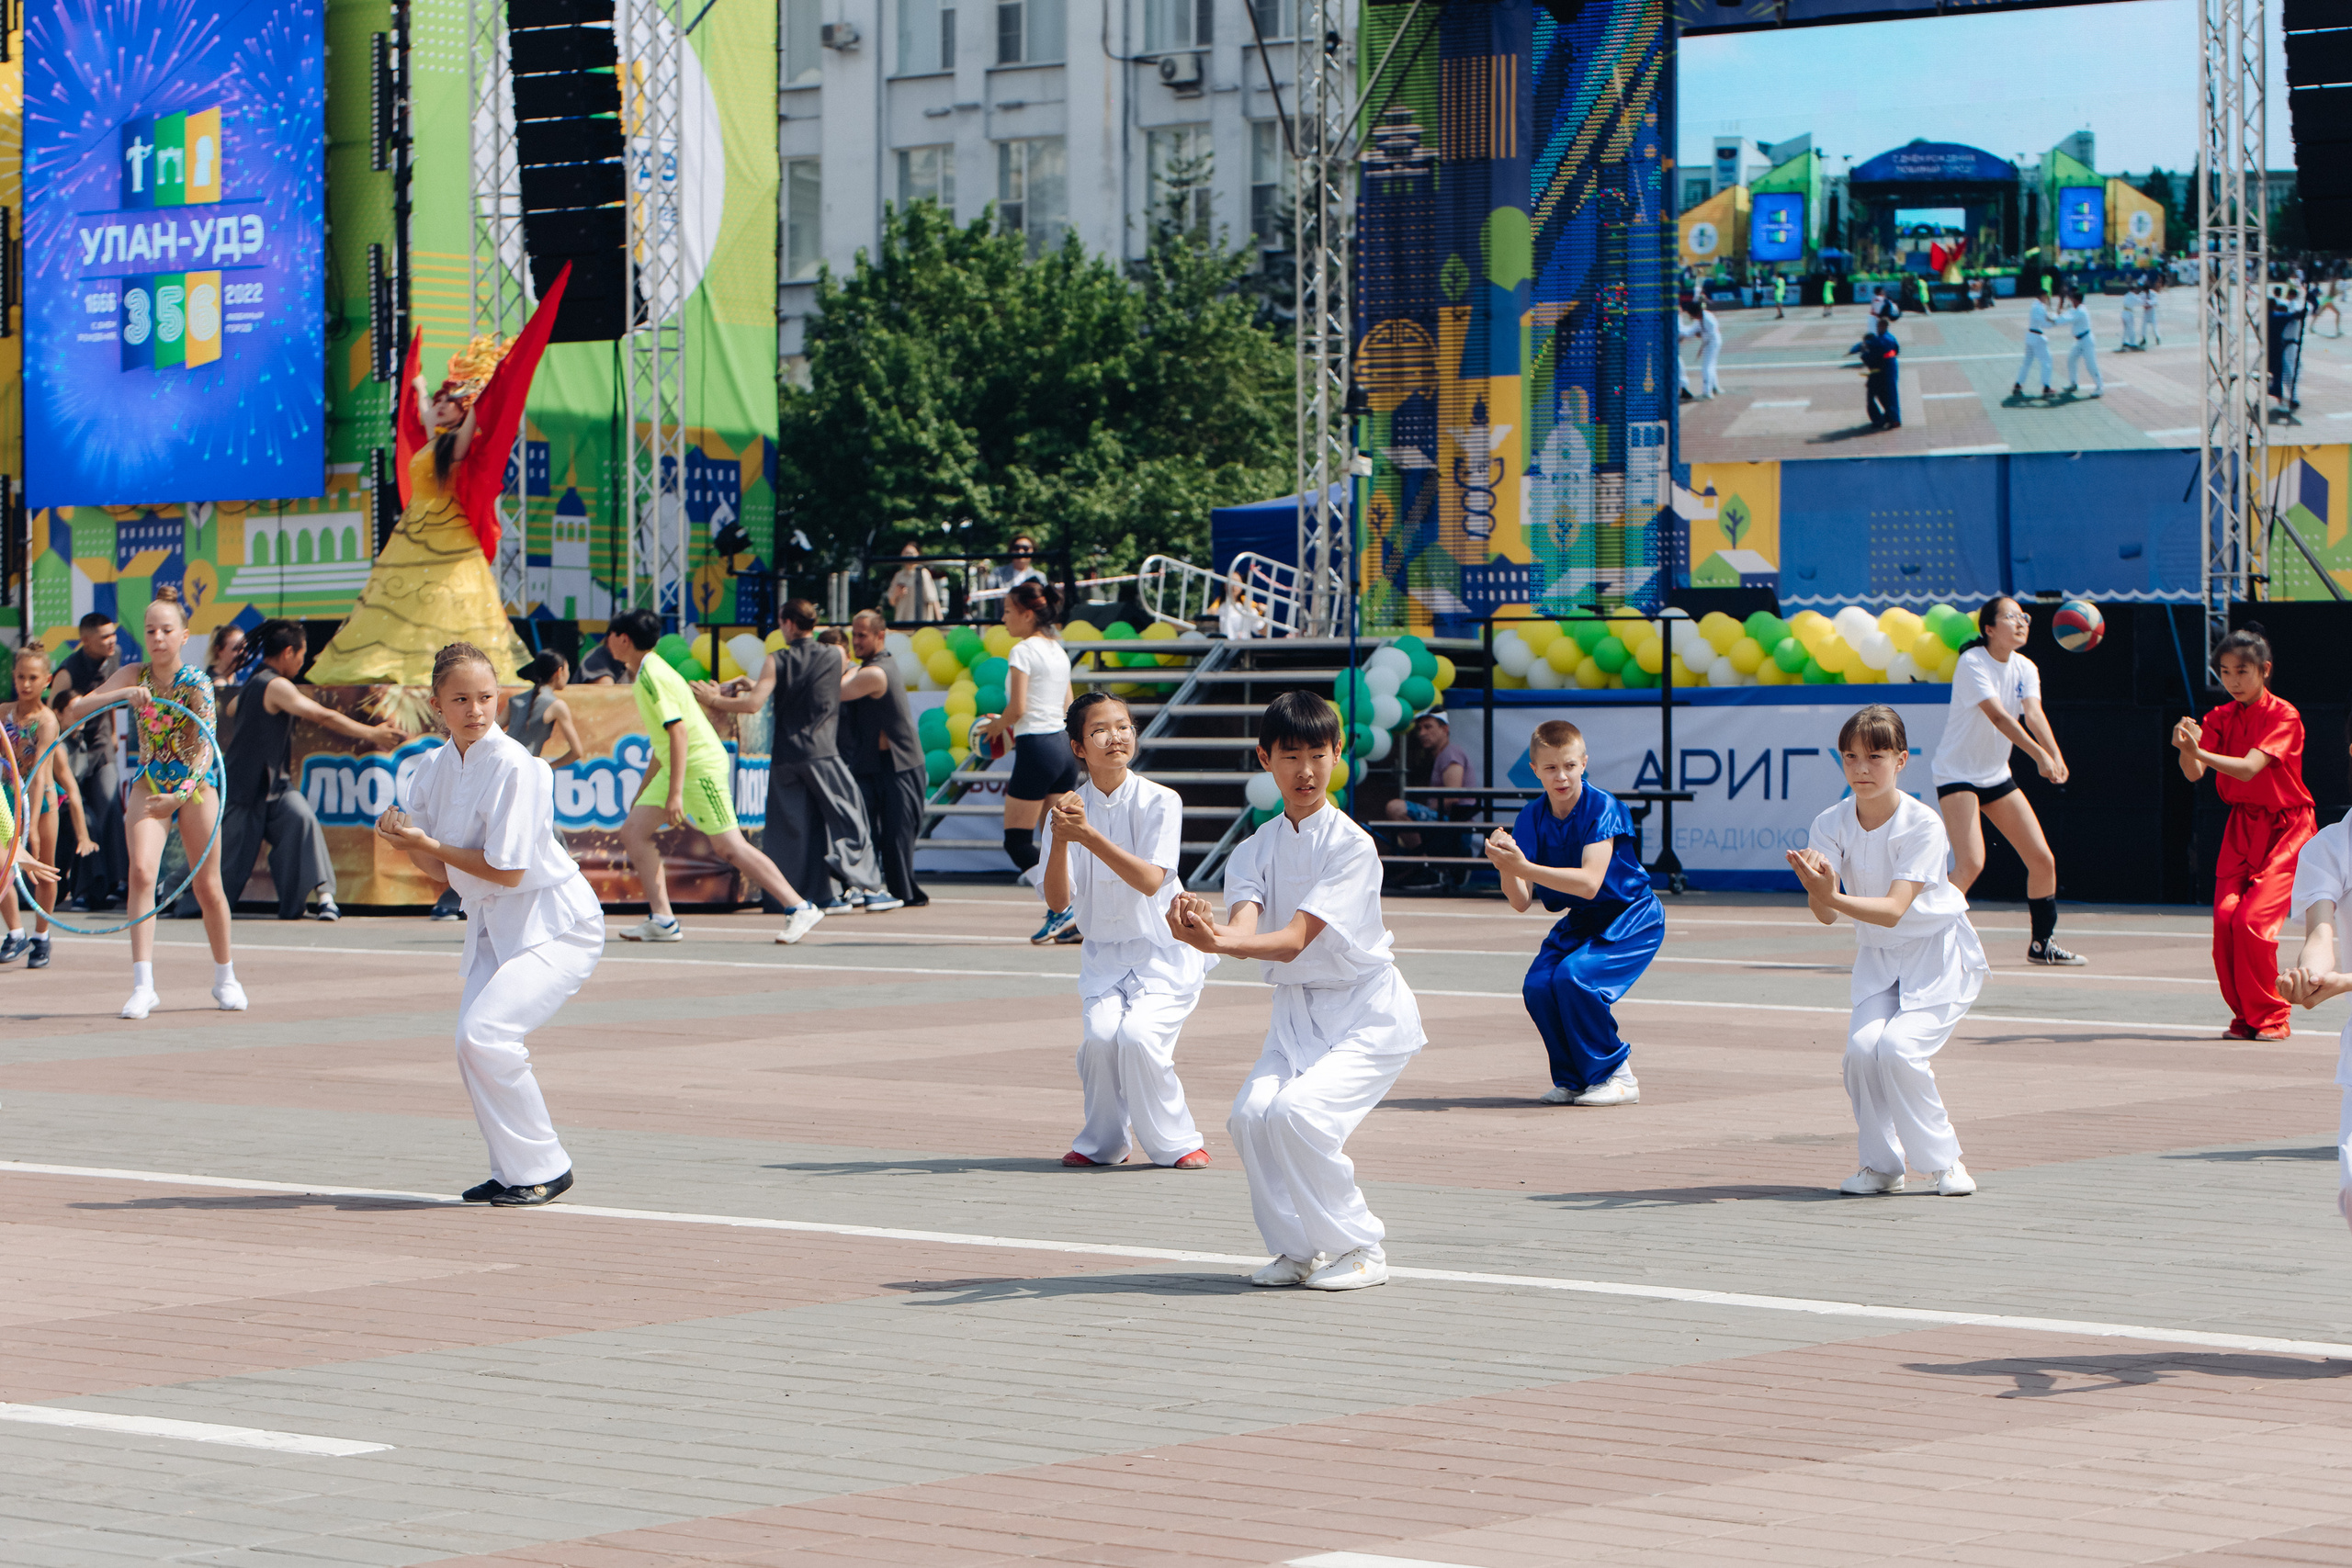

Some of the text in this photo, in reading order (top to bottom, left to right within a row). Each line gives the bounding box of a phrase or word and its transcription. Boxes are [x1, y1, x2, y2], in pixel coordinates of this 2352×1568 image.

[79, 214, 265, 265] УЛАН-УДЭ
[123, 284, 220, 345] 356
[224, 282, 264, 305] 2022
